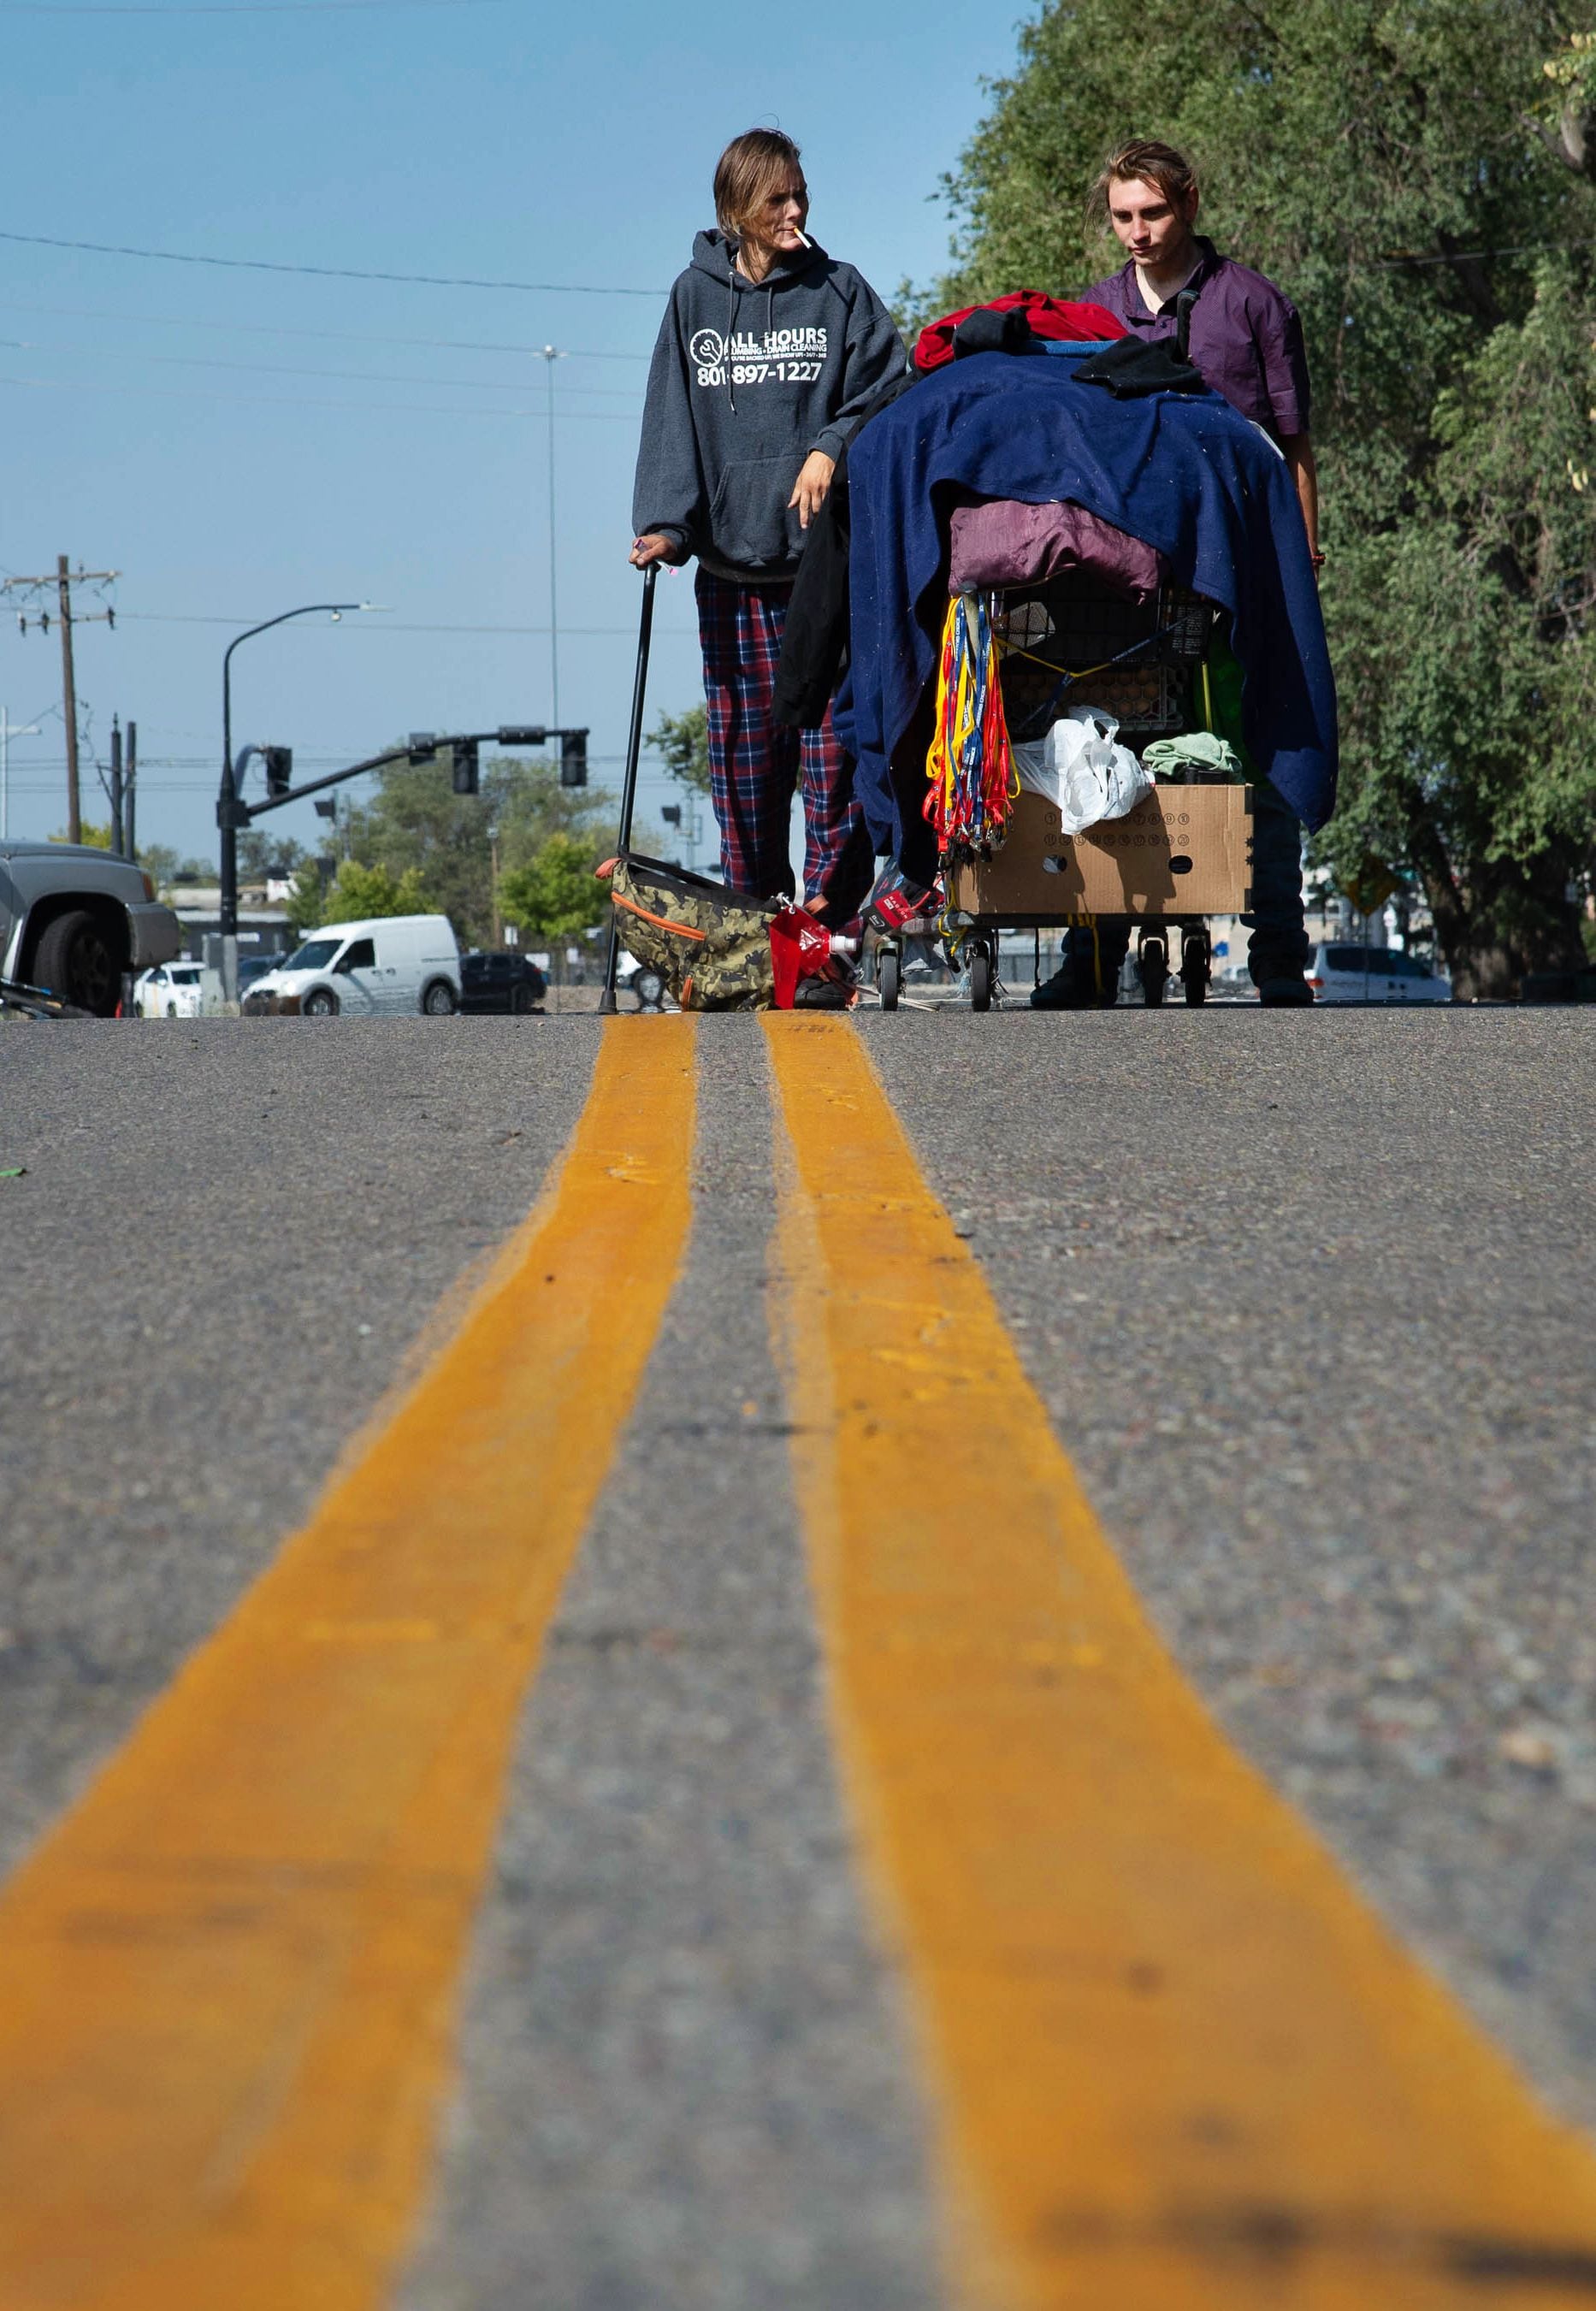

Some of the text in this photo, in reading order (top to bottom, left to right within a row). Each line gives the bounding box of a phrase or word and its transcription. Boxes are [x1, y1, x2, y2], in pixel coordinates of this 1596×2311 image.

[724, 328, 827, 348] ALL HOURS
[724, 344, 827, 357] PUMBING DRAIN CLEANING
[697, 362, 822, 387] 801-897-1227
